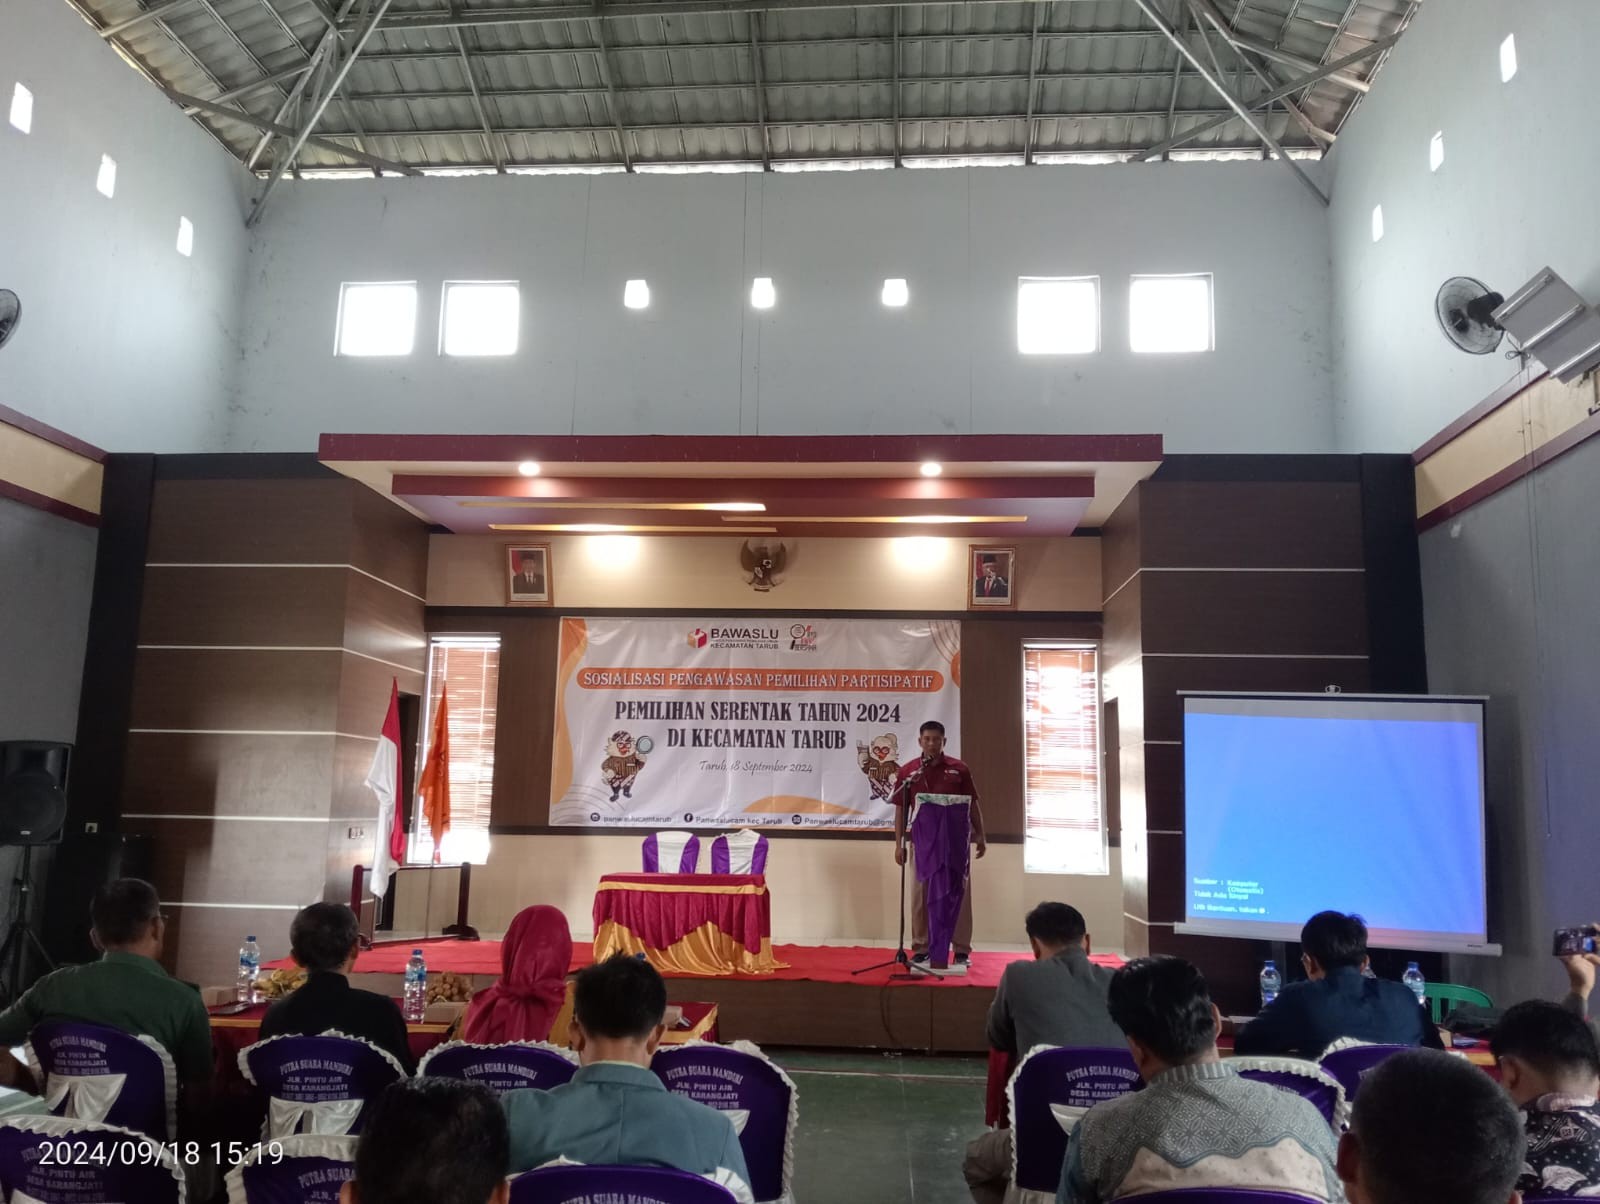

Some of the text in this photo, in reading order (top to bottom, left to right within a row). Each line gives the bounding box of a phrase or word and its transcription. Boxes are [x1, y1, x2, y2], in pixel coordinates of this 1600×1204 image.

[711, 628, 779, 639] BAWASLU
[584, 672, 933, 689] SOSIALISASI PENGAWASAN PEMILIHAN PARTISIPATIF
[615, 701, 901, 723] PEMILIHAN SERENTAK TAHUN 2024
[667, 728, 846, 749] DI KECAMATAN TARUB
[742, 759, 788, 776] September
[789, 763, 813, 773] 2024
[298, 1169, 326, 1189] PUTRA
